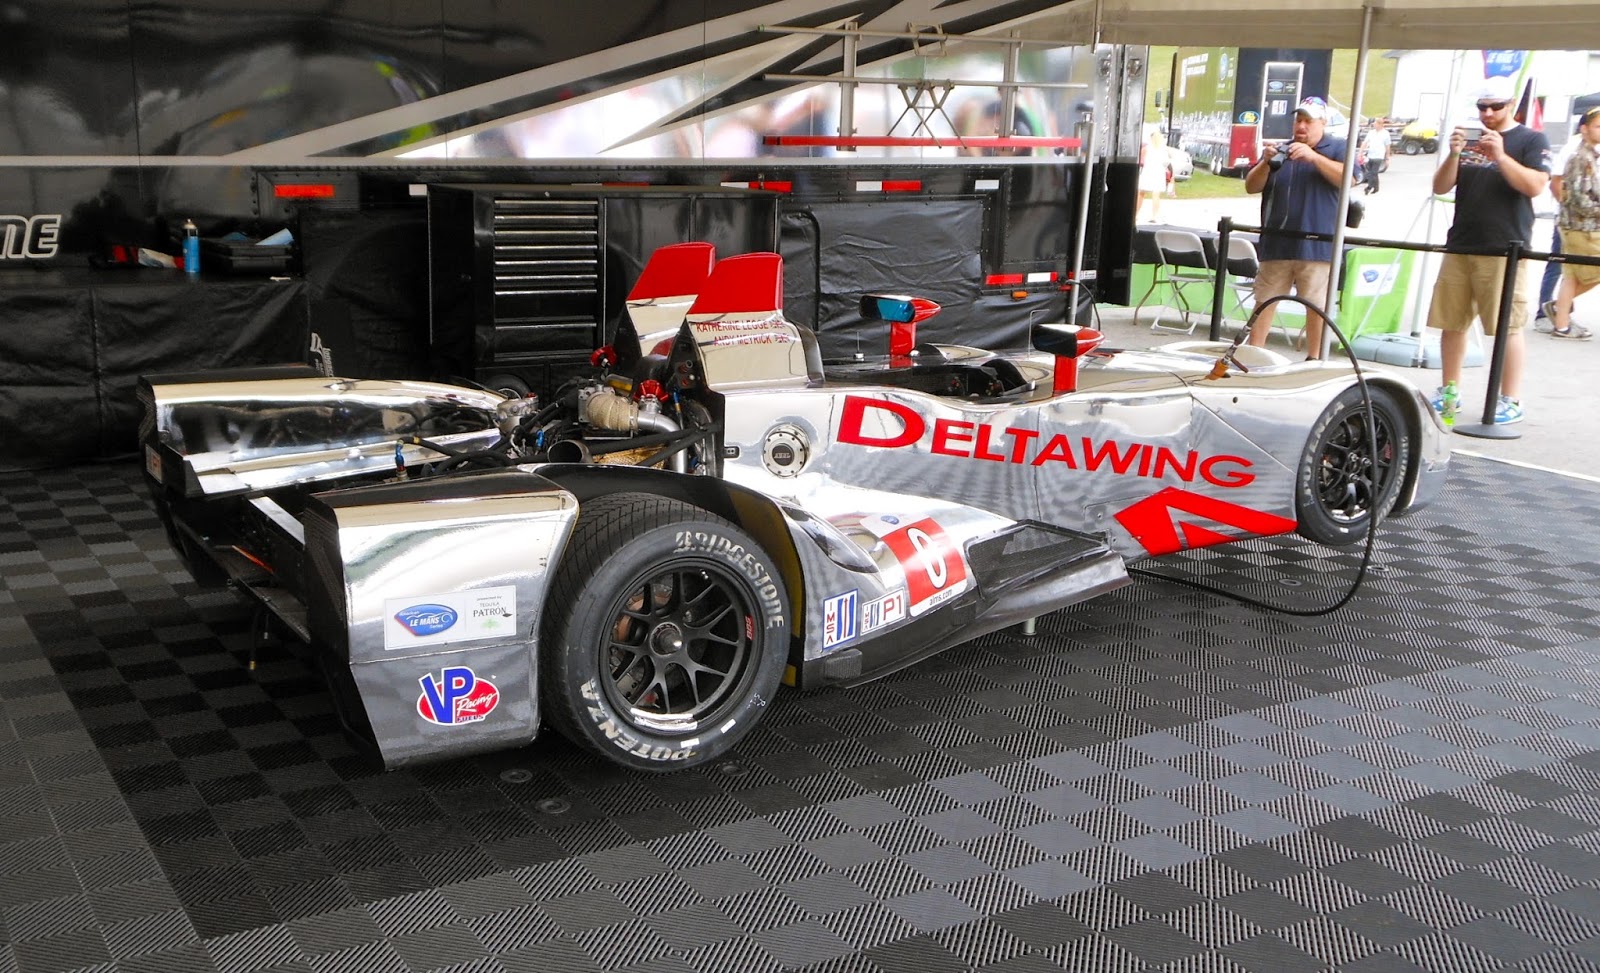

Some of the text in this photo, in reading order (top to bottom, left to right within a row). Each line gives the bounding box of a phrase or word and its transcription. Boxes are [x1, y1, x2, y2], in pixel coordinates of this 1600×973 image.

[696, 320, 741, 332] KATHERINE
[836, 394, 1256, 488] DELTAWING
[673, 530, 784, 630] BRIDGESTONE
[410, 616, 440, 627] LE MANS
[826, 602, 836, 645] IMSA
[883, 595, 903, 621] P1
[419, 666, 476, 725] VP
[456, 692, 498, 717] Racing
